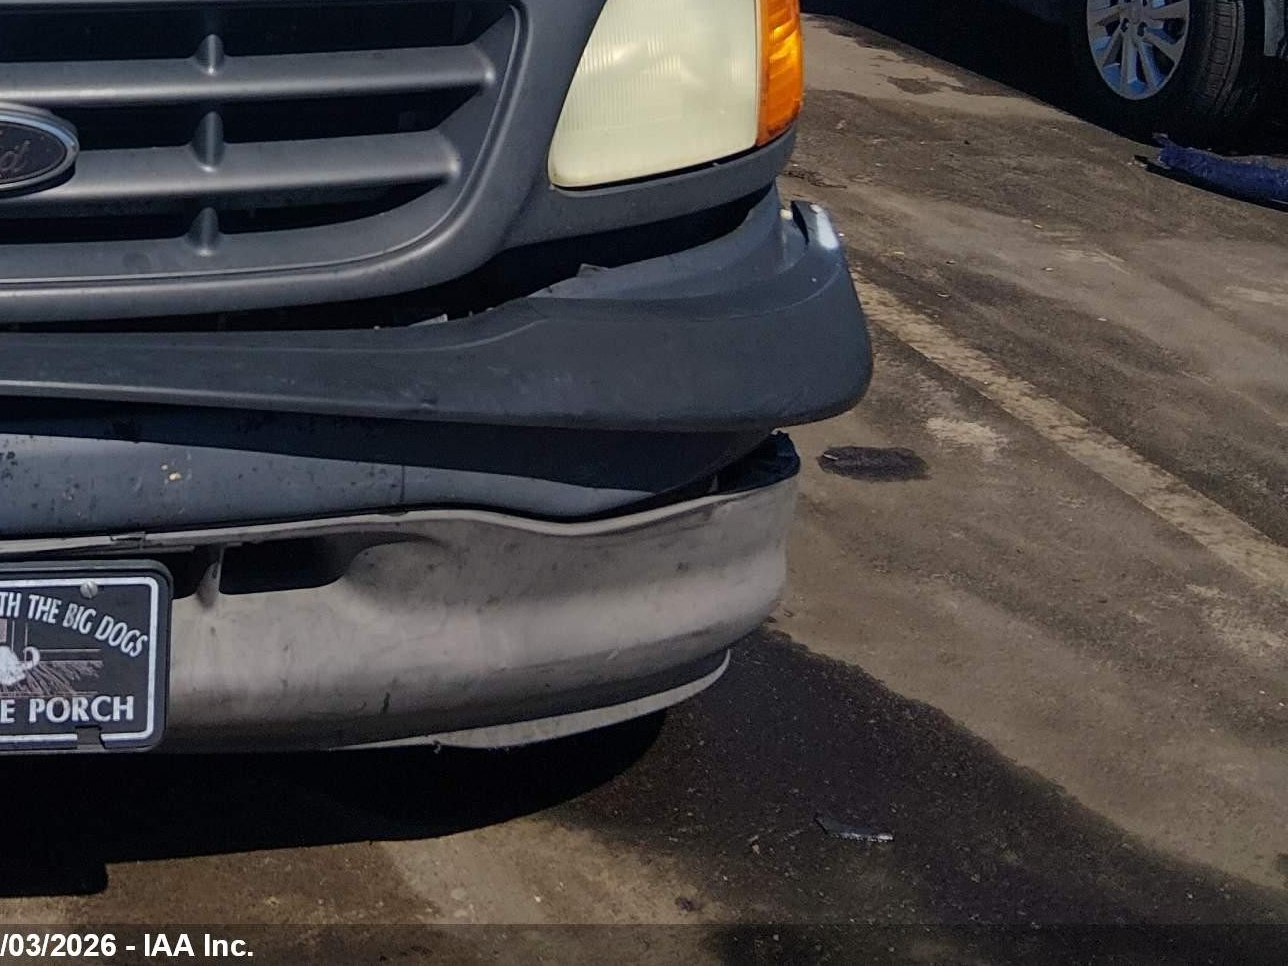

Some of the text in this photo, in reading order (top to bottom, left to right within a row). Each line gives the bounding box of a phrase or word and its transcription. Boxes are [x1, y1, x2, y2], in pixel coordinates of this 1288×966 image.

[27, 594, 59, 624] THE
[62, 602, 92, 635] BIG
[95, 614, 148, 657] DOGS
[29, 695, 134, 723] PORCH
